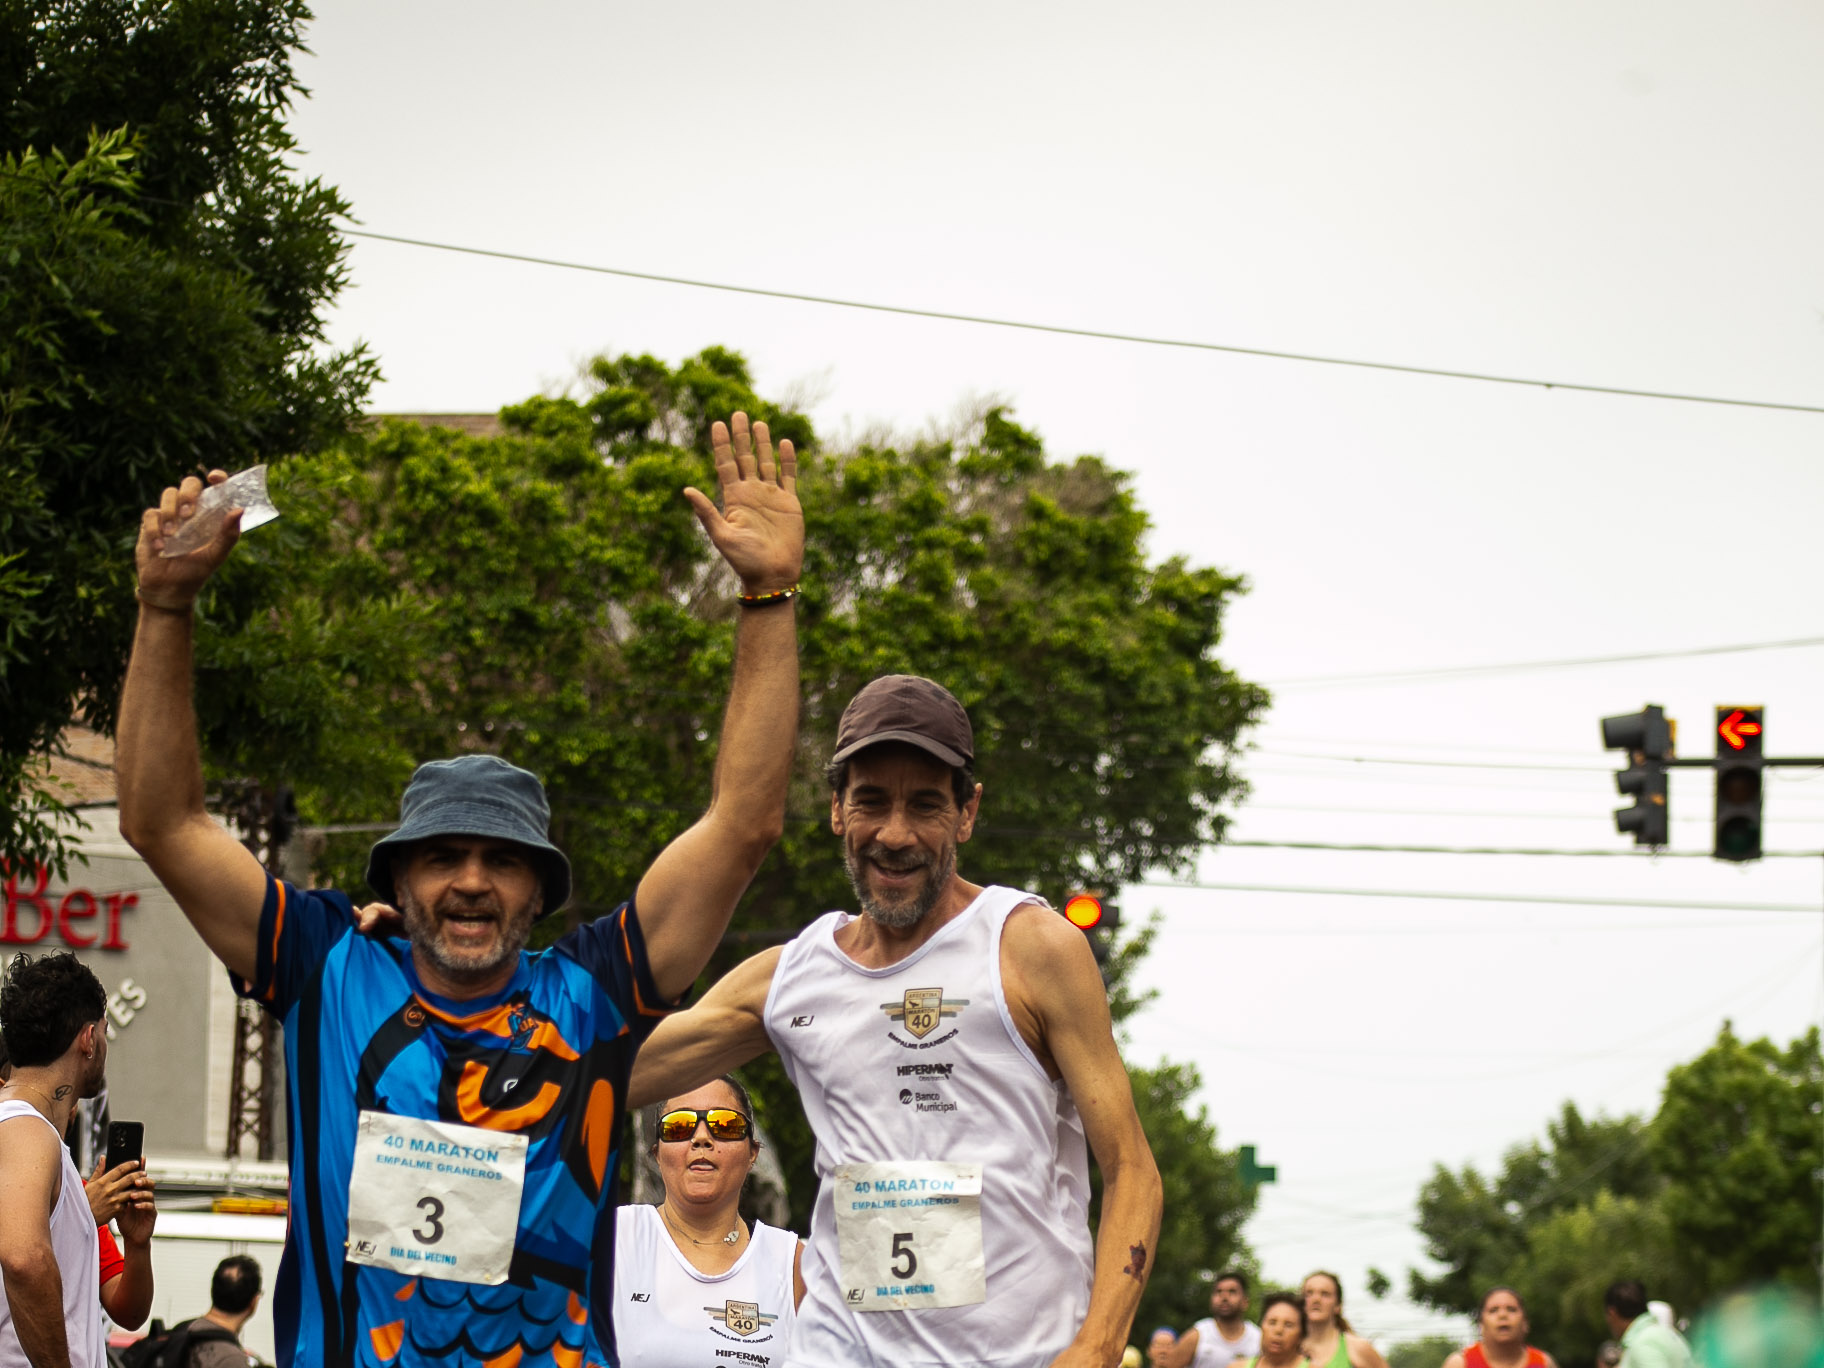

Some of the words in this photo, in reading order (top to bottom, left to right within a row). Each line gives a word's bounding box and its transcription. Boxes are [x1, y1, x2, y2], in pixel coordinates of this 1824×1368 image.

[790, 1015, 815, 1028] NEJ
[912, 1014, 931, 1029] 40
[887, 1031, 918, 1050] EMPALME
[919, 1028, 959, 1050] GRANEROS
[915, 1092, 940, 1101] Banco
[916, 1101, 957, 1113] Municipal
[384, 1135, 404, 1149] 40
[410, 1139, 499, 1163] MARATON
[376, 1154, 433, 1170] EMPALME
[437, 1163, 503, 1181] GRANEROS
[855, 1181, 870, 1194] 40
[875, 1179, 955, 1192] MARATON
[852, 1200, 897, 1210] EMPALME
[900, 1197, 960, 1208] GRANEROS
[412, 1196, 445, 1245] 3
[355, 1240, 377, 1255] NEJ
[390, 1247, 405, 1258] DIA
[407, 1249, 422, 1260] DEL
[425, 1252, 457, 1266] VECINO
[891, 1232, 917, 1280] 5
[631, 1293, 650, 1302] NEJ
[847, 1288, 865, 1301] NEJ
[876, 1284, 889, 1296] DIA
[890, 1285, 903, 1296] DEL
[733, 1320, 753, 1330] 40
